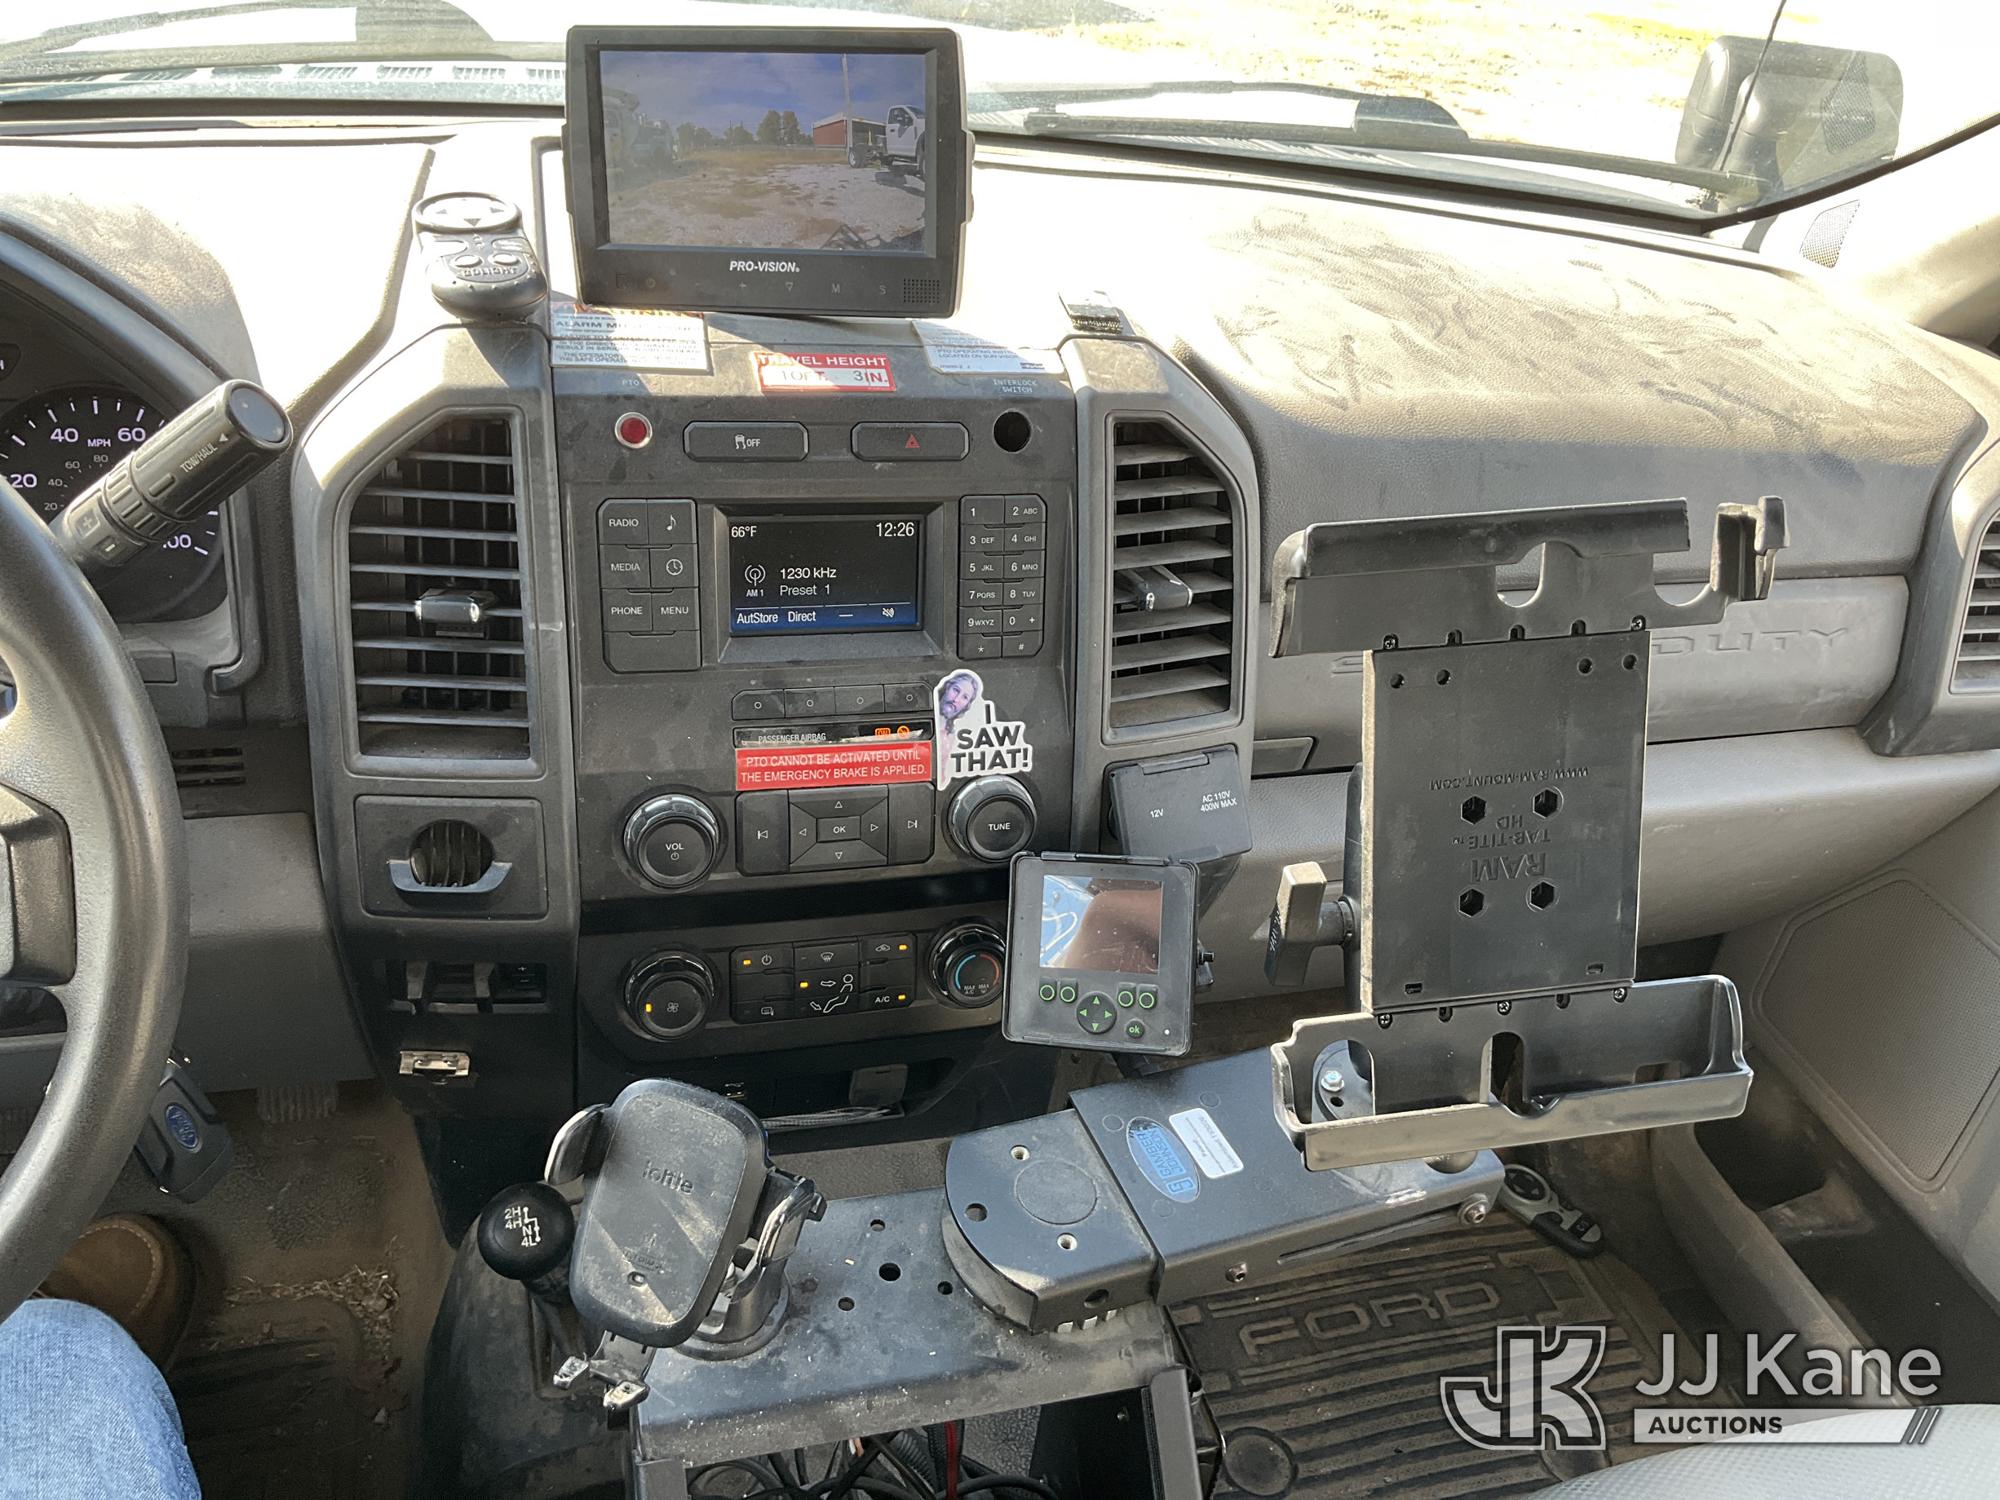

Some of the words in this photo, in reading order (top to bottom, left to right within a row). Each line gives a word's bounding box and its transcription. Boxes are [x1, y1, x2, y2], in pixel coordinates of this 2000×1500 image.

[826, 357, 887, 367] HEIGHT
[50, 428, 79, 443] 40
[117, 428, 146, 442] 60
[87, 438, 111, 448] MPH
[746, 438, 761, 447] OFF
[93, 454, 109, 464] 80
[180, 444, 218, 473] TOW/HAUL
[65, 460, 80, 470] 60
[10, 474, 37, 489] 20
[48, 478, 63, 487] 40
[44, 502, 58, 511] 20
[1012, 507, 1019, 516] 2
[1023, 507, 1038, 515] ABC
[970, 508, 976, 517] 1
[609, 518, 639, 527] RADIO
[731, 526, 757, 538] 66°F
[876, 522, 915, 537] 12:26
[162, 534, 192, 549] 00
[970, 536, 976, 545] 3
[1011, 534, 1018, 543] 4
[611, 563, 641, 572] MEDIA
[970, 563, 976, 572] 5
[981, 564, 994, 572] JKL
[1011, 563, 1018, 571] 6
[1022, 563, 1039, 571] MNO
[780, 567, 811, 579] 1230
[813, 567, 837, 578] kHz
[780, 584, 817, 596] Preset
[825, 584, 830, 595] 1
[1009, 590, 1016, 599] 8
[969, 591, 976, 599] 7
[976, 591, 996, 600] PQRS
[611, 606, 643, 615] PHONE
[660, 606, 689, 614] MENU
[737, 612, 779, 624] AutStore
[788, 610, 816, 622] Direct
[1009, 616, 1016, 625] 0
[968, 618, 975, 627] 9
[985, 703, 991, 724] I
[758, 734, 800, 743] PASSENGER
[801, 733, 827, 742] AIRBAG
[957, 725, 1021, 749] SAW
[746, 756, 768, 767] PTO
[770, 754, 815, 766] CANNOT
[816, 754, 830, 765] BE
[833, 752, 890, 764] ACTIVATED
[892, 750, 921, 761] UNTIL
[951, 748, 1029, 773] THAT!
[741, 772, 762, 782] THE
[764, 769, 831, 782] EMERGENCY
[834, 767, 867, 779] BRAKE
[871, 766, 881, 776] IS
[883, 764, 927, 776] APPLIED.
[1429, 766, 1589, 791] WWW.RAM-MOUNT.COM
[1202, 793, 1213, 803] AC
[1213, 790, 1231, 801] 110V
[1200, 801, 1219, 812] 400W
[1220, 798, 1238, 809] MAX
[1150, 808, 1164, 818] 12V
[988, 822, 1011, 831] TUNE
[1496, 814, 1524, 829] HD
[833, 825, 846, 834] OK
[665, 843, 685, 851] VOL
[1471, 852, 1547, 882] RAM
[875, 995, 890, 1004] A/C
[1129, 1025, 1141, 1034] ok
[504, 1206, 521, 1219] 2H
[505, 1217, 522, 1230] 4H
[522, 1224, 532, 1237] N
[521, 1236, 537, 1247] 4L
[1239, 1283, 1499, 1357] FORD
